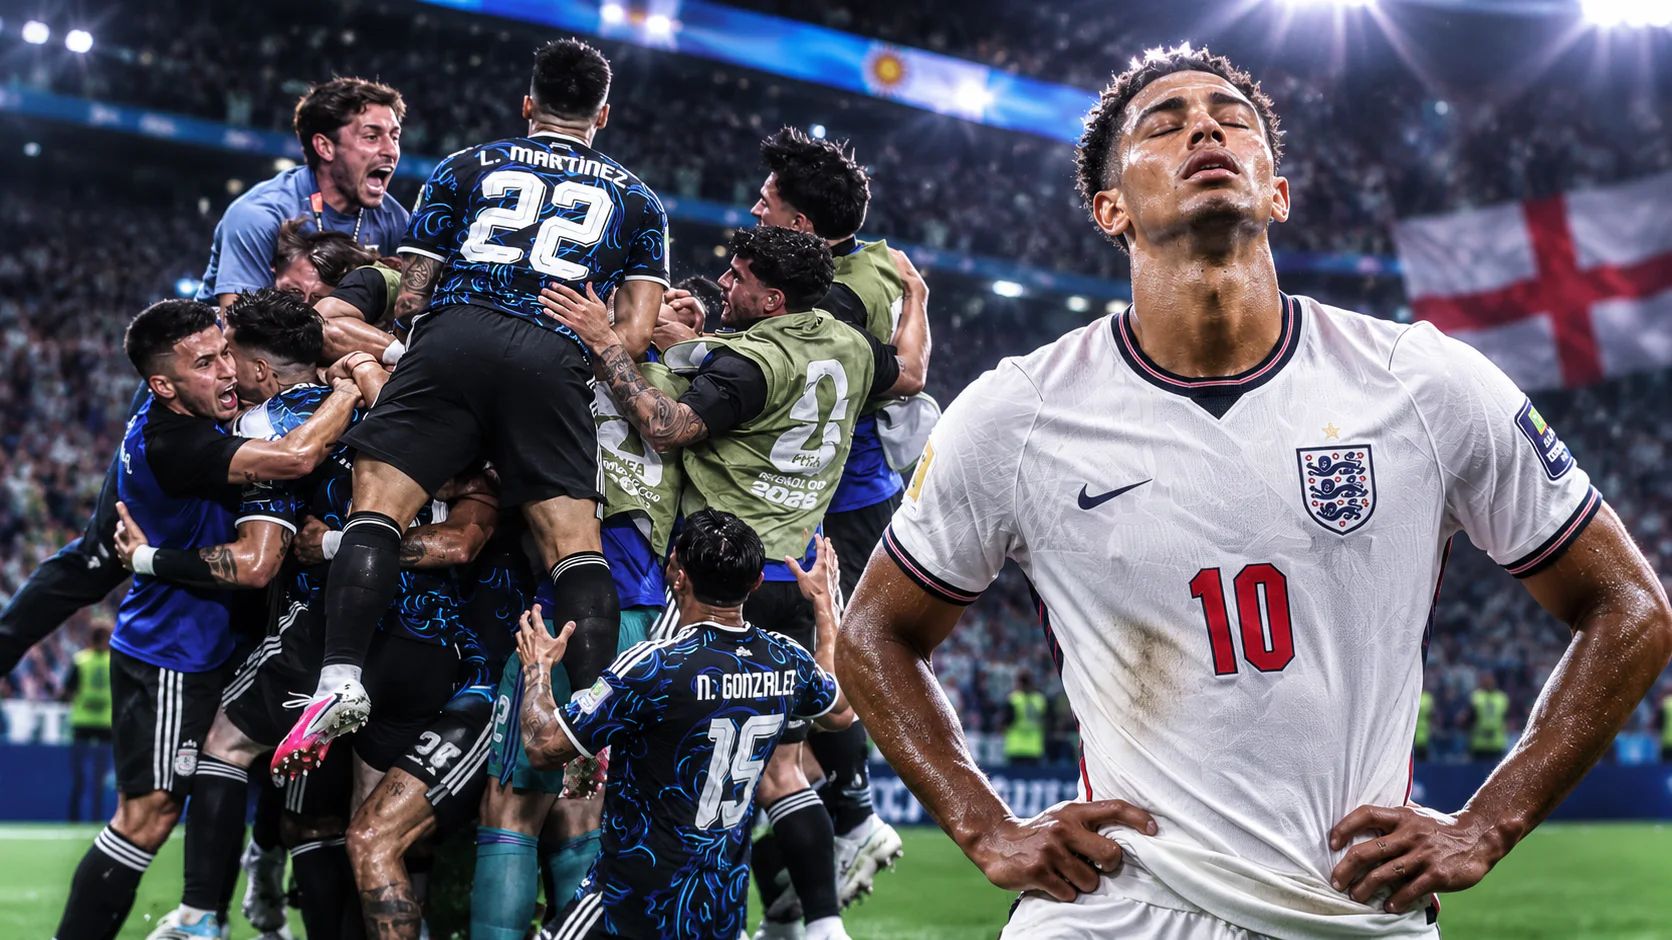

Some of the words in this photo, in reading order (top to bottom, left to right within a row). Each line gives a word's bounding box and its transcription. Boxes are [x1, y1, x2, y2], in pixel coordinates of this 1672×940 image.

[480, 150, 501, 166] L.
[460, 170, 614, 281] 22
[751, 480, 819, 511] 2026
[1188, 562, 1296, 676] 10
[695, 713, 785, 830] 15
